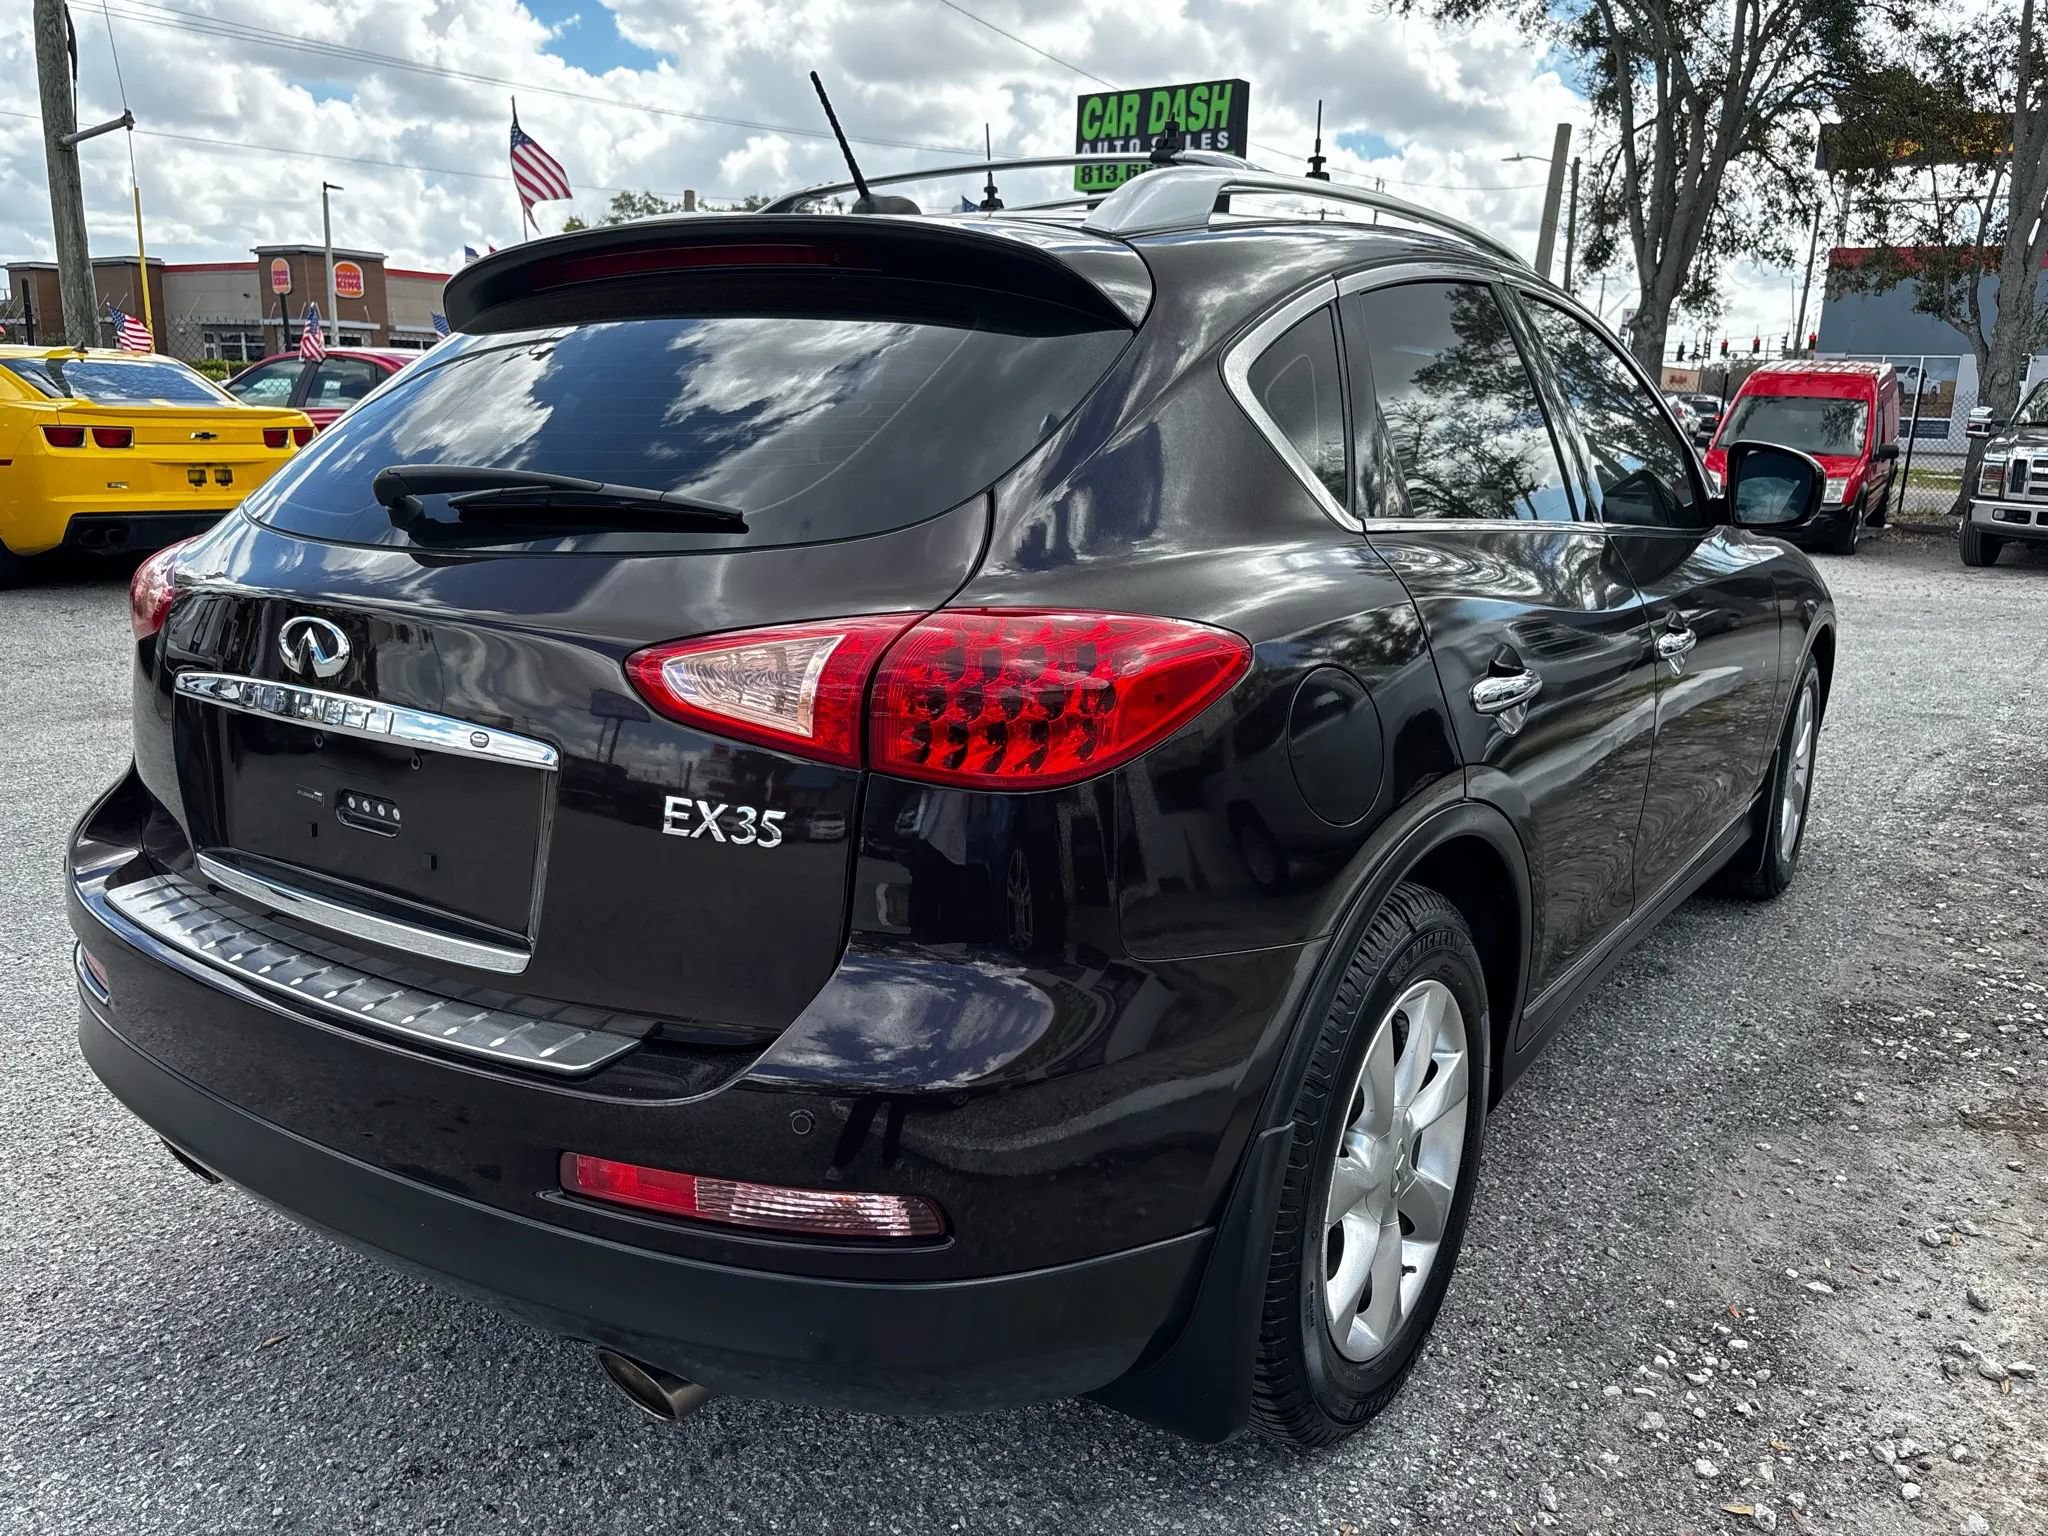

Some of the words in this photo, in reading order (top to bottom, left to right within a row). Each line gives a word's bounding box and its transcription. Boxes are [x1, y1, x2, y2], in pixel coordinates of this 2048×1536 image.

[1081, 93, 1141, 141] CAR
[1147, 83, 1232, 135] DASH
[1081, 138, 1141, 154] AUTO
[1150, 131, 1229, 152] SLES
[662, 795, 787, 848] EX35
[1412, 930, 1464, 958] MICHELIN
